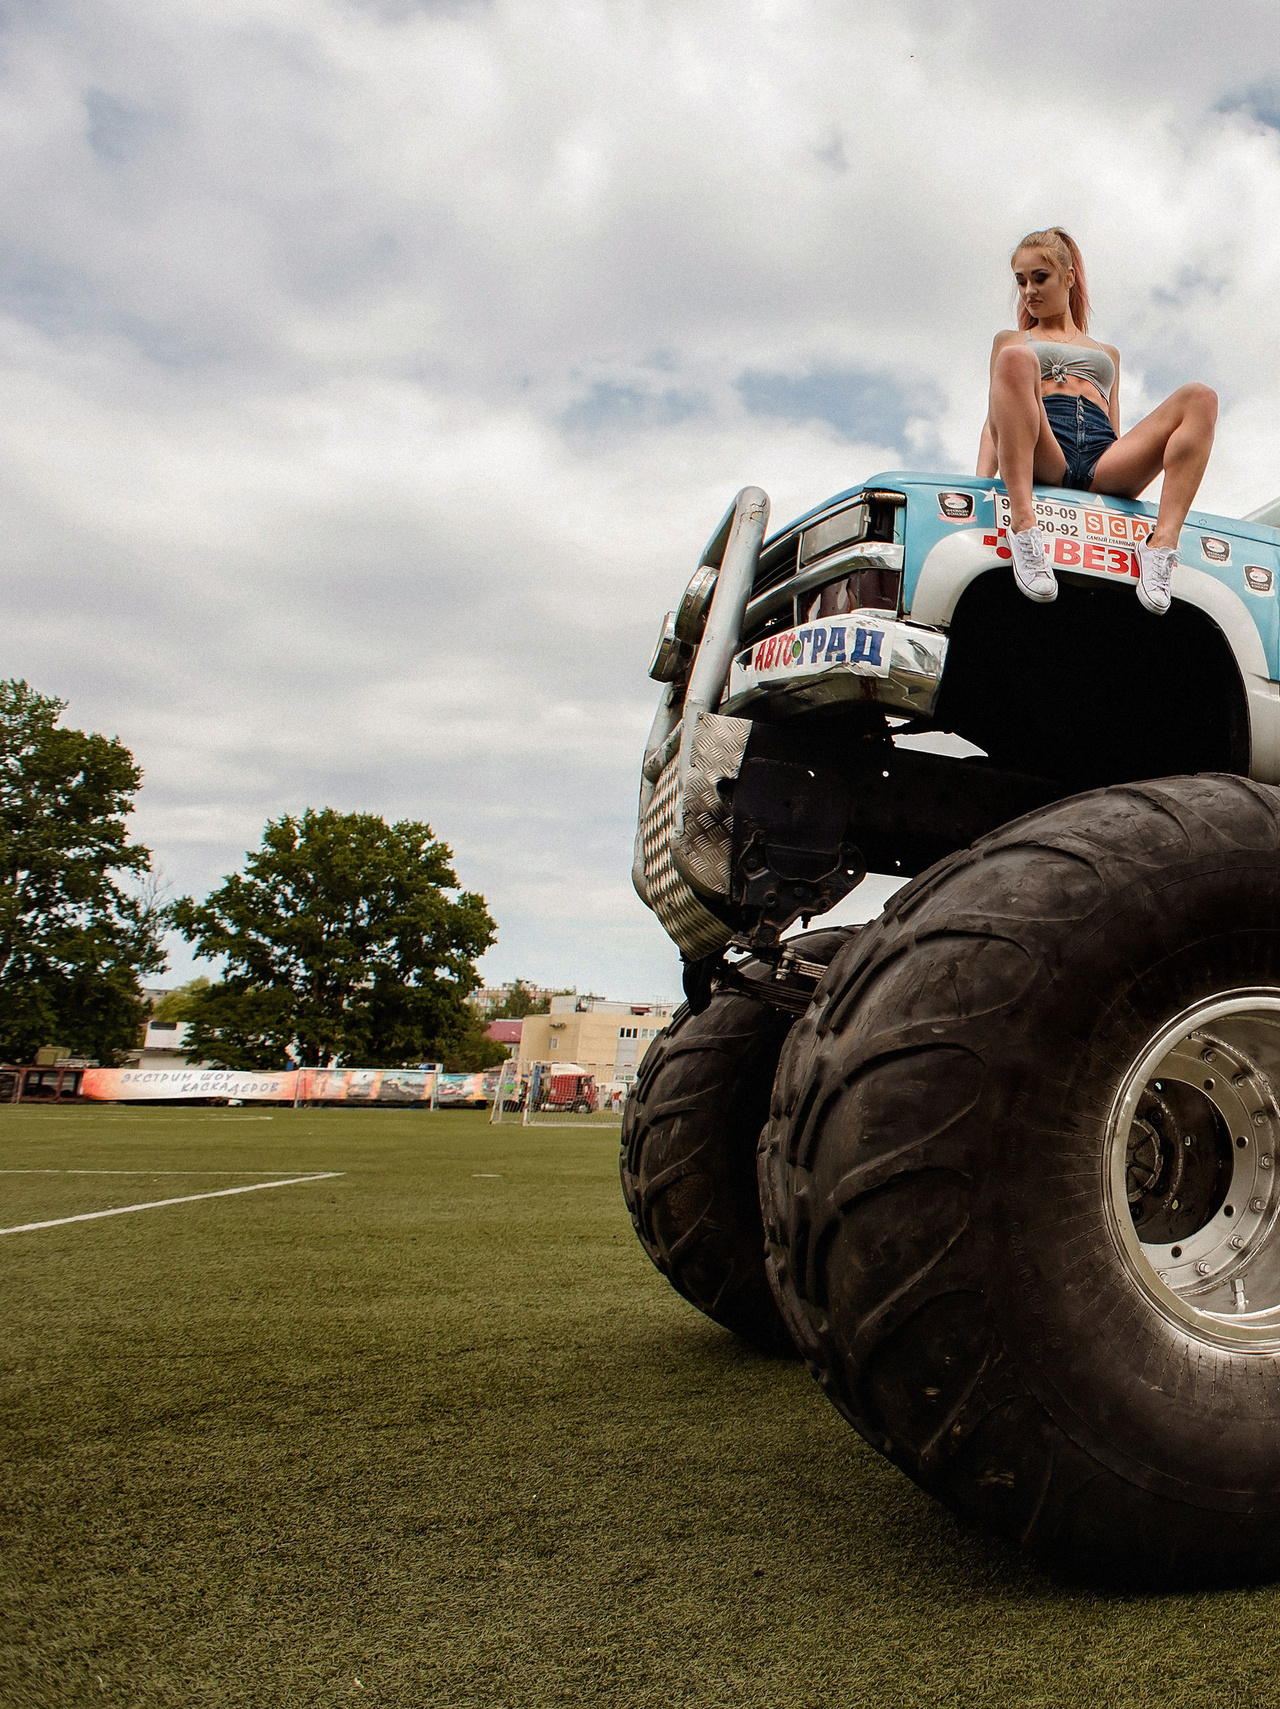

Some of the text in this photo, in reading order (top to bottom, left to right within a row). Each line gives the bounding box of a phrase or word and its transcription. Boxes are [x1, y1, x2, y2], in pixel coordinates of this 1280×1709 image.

[1087, 514, 1148, 539] SGA
[200, 1073, 234, 1082] ШОУ
[180, 1082, 280, 1094] КАСКАДЕРОВ
